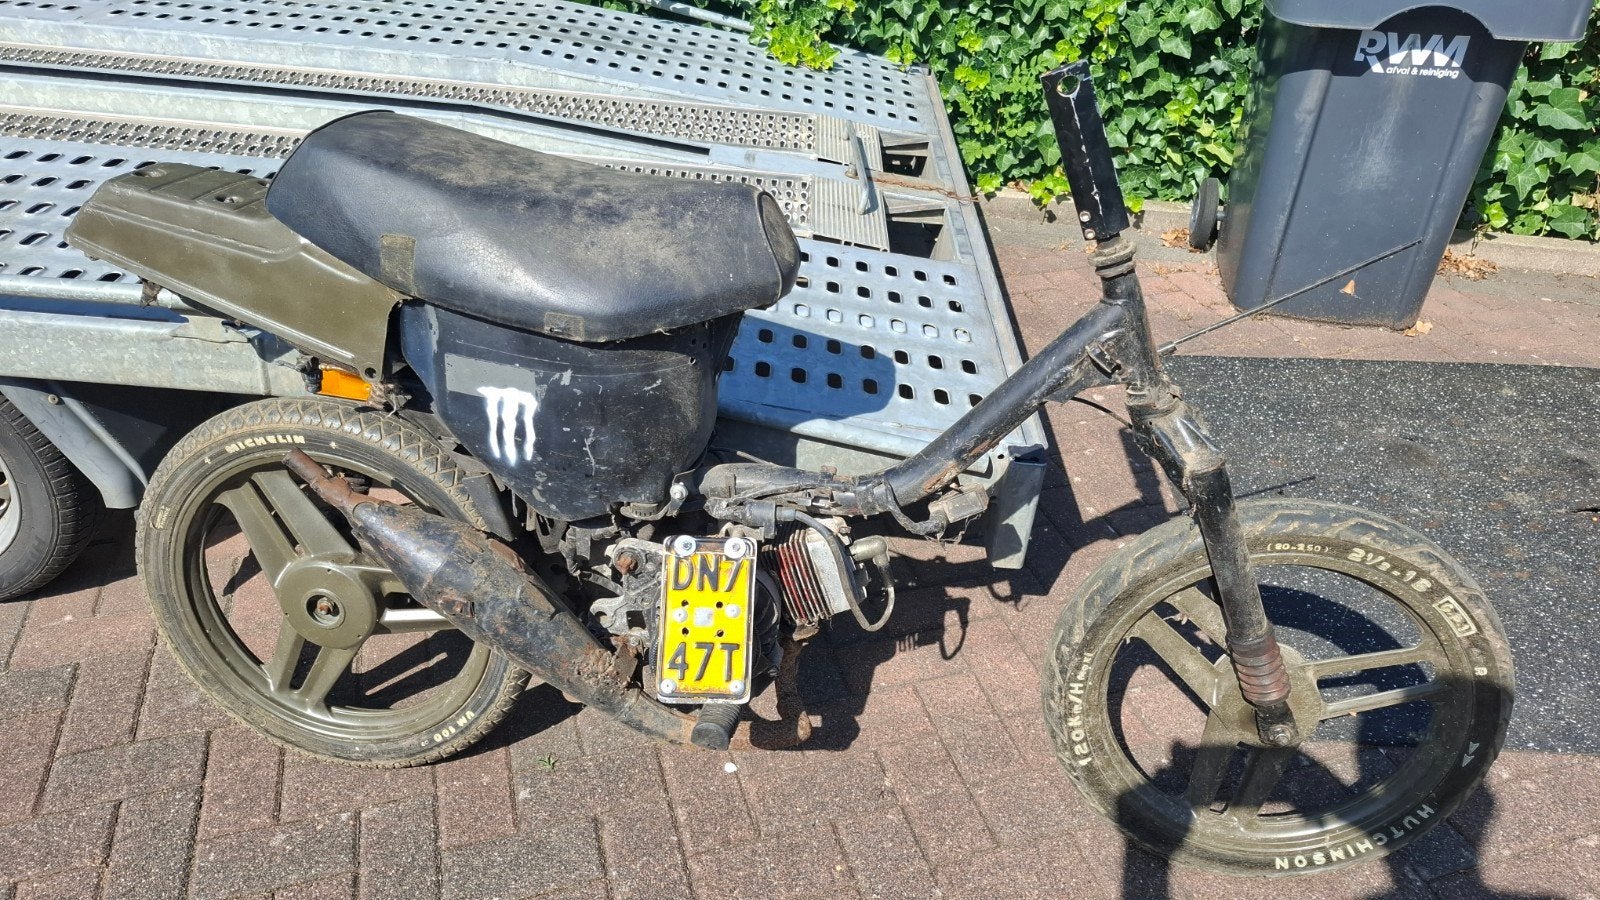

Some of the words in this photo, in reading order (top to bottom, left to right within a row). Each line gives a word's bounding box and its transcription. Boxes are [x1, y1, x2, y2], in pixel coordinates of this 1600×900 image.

[1354, 30, 1471, 73] RWM
[1386, 66, 1410, 75] afval
[1411, 67, 1418, 75] &
[1419, 68, 1460, 79] reiniging
[225, 434, 305, 453] MICHELIN
[672, 554, 743, 592] DN7
[667, 641, 740, 682] 47T
[434, 726, 456, 742] 100
[1274, 804, 1434, 870] HUTCHINSON
